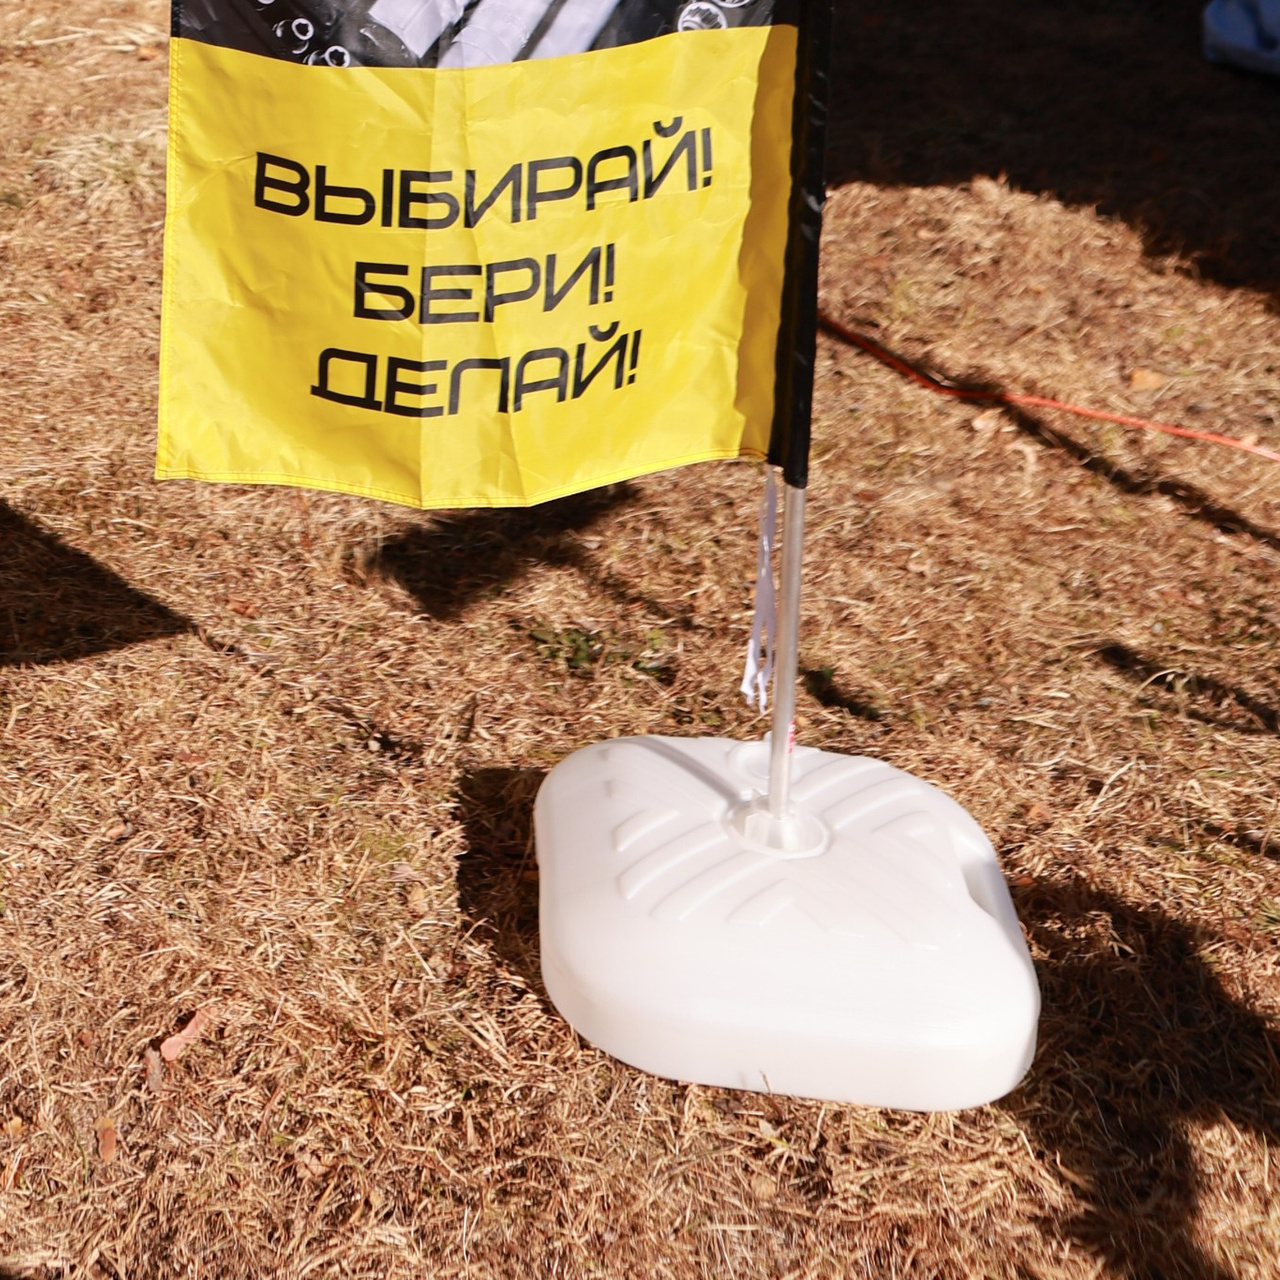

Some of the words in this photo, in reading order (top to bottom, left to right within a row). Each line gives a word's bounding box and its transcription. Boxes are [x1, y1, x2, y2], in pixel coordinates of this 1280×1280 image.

[253, 115, 714, 231] ВЫБИРАЙ!
[352, 243, 617, 326] БЕРИ!
[310, 320, 642, 419] ДЕЛАЙ!
